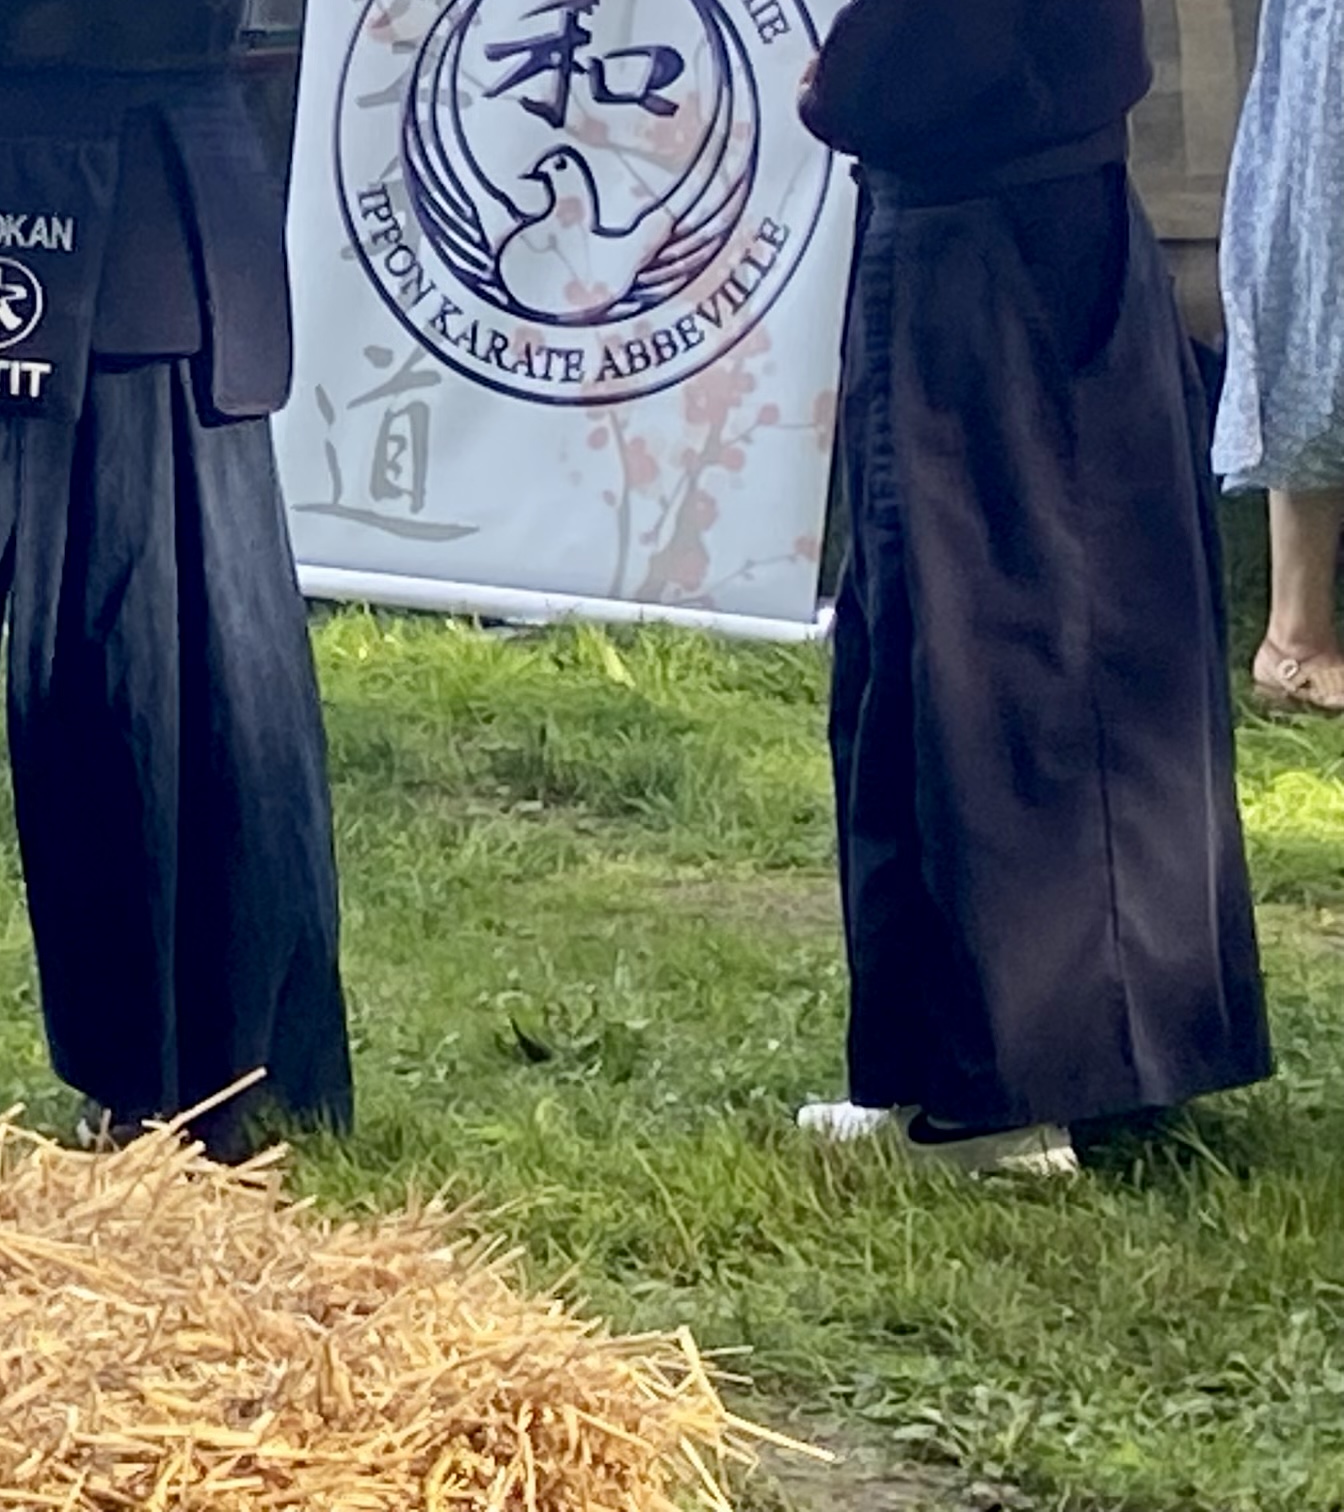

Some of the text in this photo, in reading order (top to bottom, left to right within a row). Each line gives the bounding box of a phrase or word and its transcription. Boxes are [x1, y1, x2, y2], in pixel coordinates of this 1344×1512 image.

[356, 181, 791, 383] IPPON KARATE ABBEVILLE
